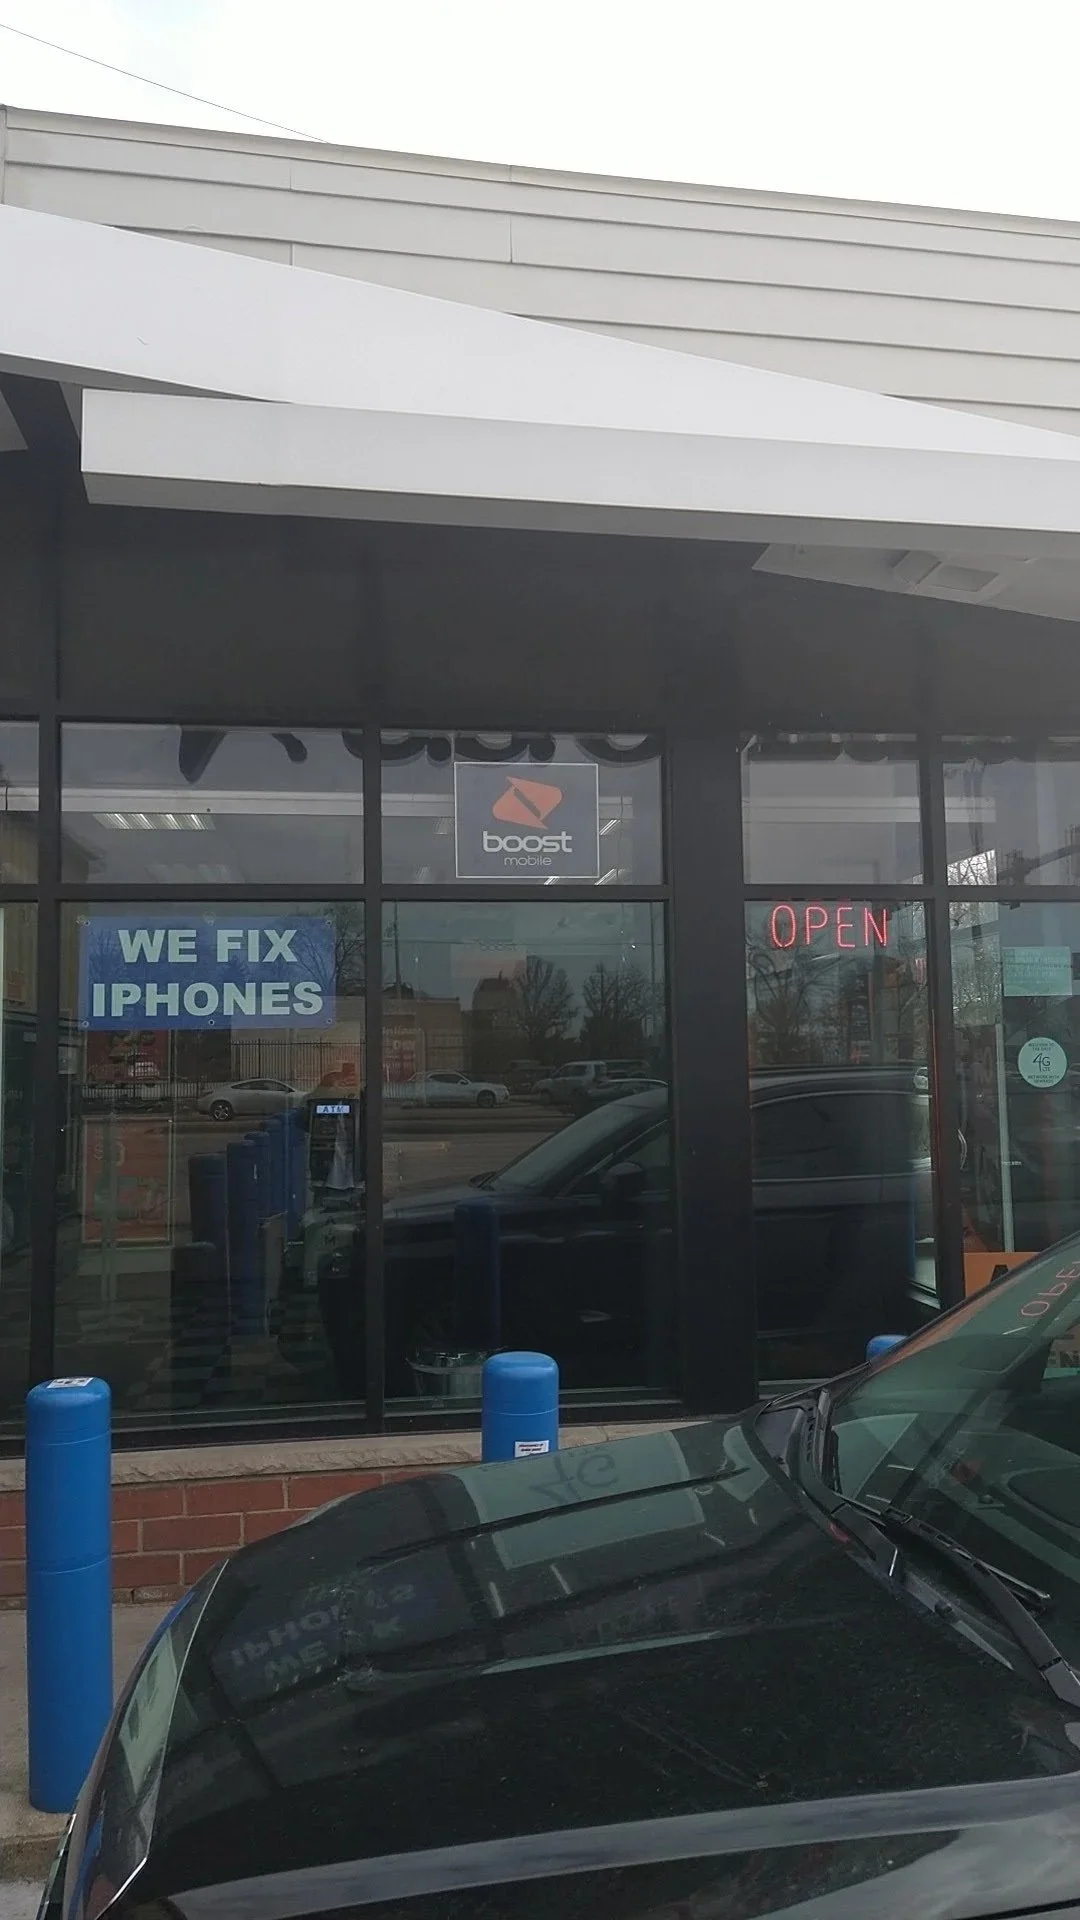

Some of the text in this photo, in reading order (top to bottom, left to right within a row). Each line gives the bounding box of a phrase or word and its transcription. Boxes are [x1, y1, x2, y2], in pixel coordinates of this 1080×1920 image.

[483, 831, 573, 853] boost
[503, 855, 552, 867] mobile
[771, 904, 888, 948] OPEN
[117, 929, 298, 963] WE FIX
[92, 981, 324, 1018] IPHONES
[1032, 1052, 1051, 1072] 4G
